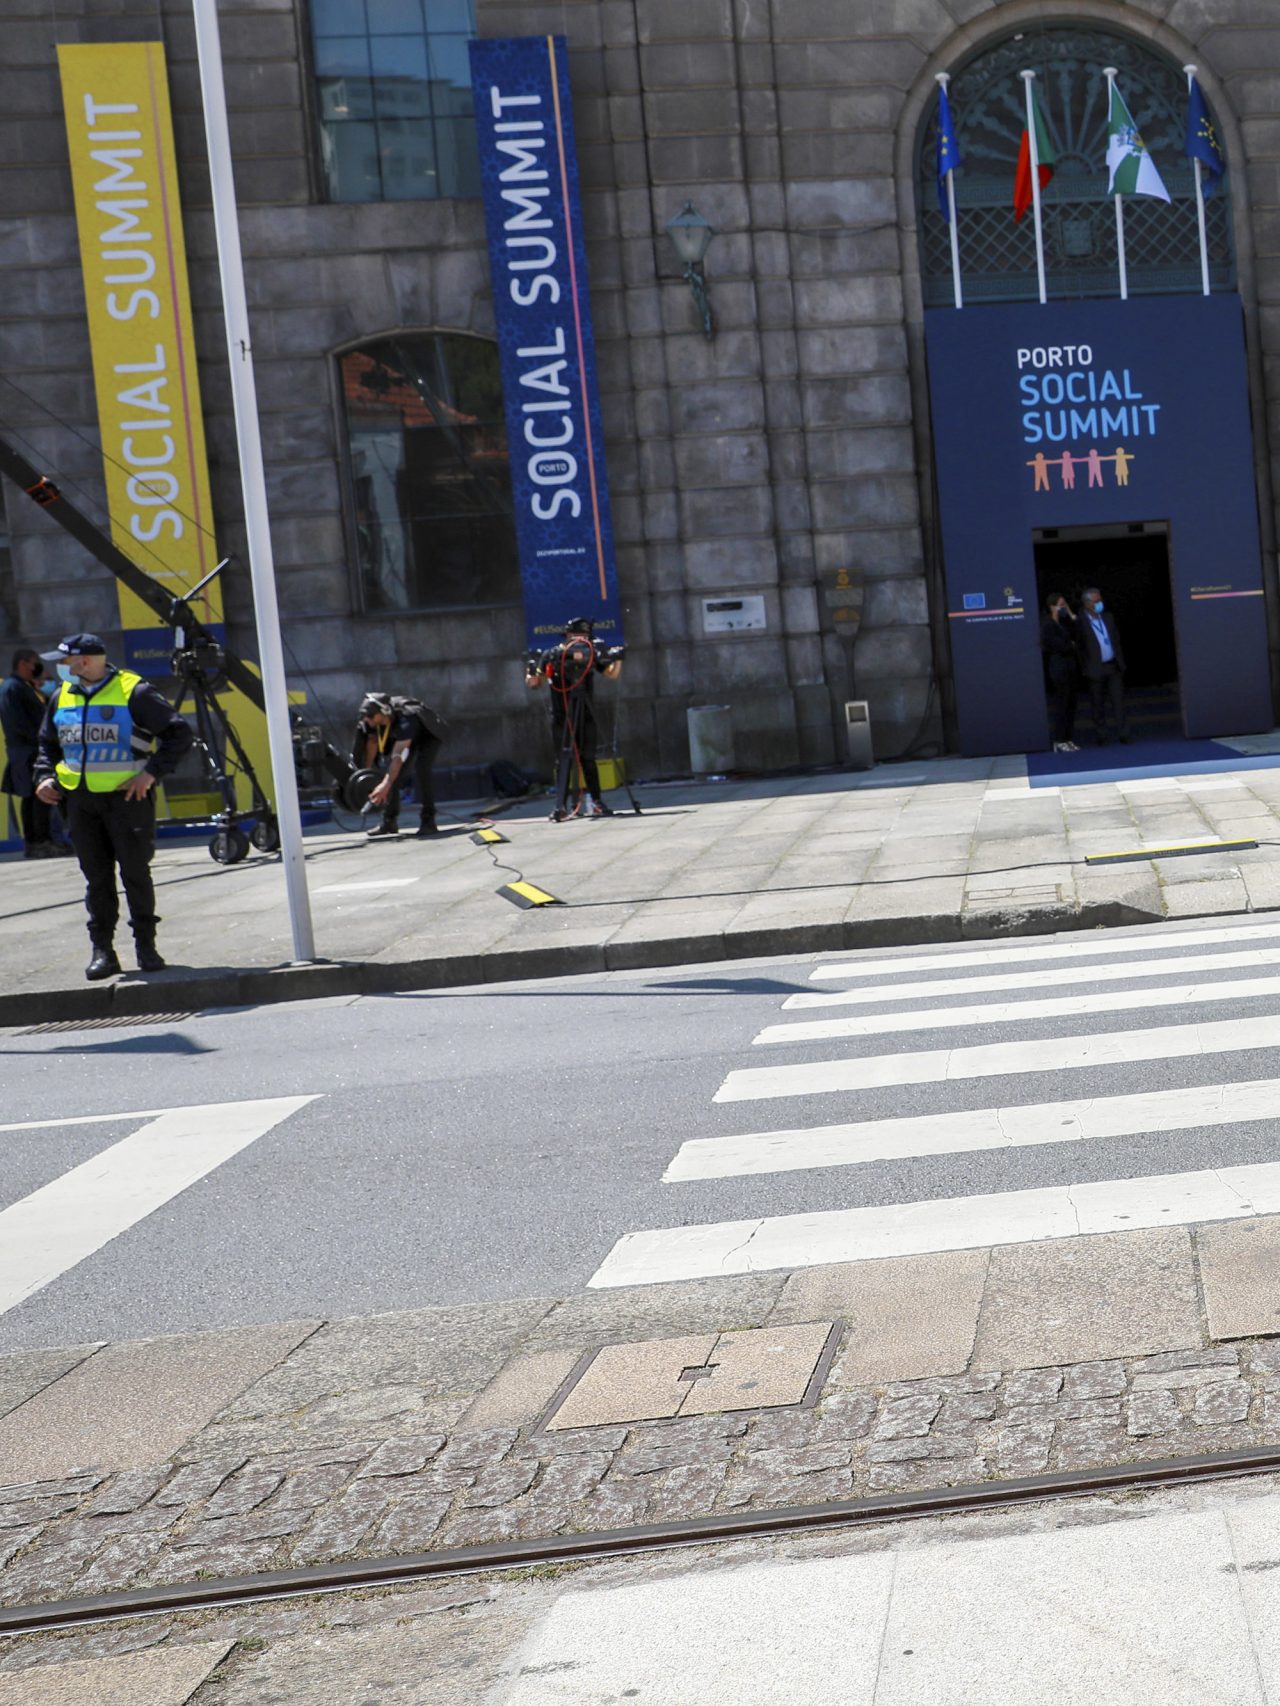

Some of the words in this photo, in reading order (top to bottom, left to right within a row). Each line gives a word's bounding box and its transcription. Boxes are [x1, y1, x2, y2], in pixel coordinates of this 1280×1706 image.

[84, 93, 160, 321] SUMMIT
[490, 85, 560, 306] SUMMIT
[1017, 345, 1093, 370] PORTO
[1019, 369, 1143, 406] SOCIAL
[114, 343, 183, 541] SOCIAL
[516, 326, 581, 520] SOCIAL
[538, 463, 567, 473] PORTO
[1022, 404, 1161, 443] SUMMIT
